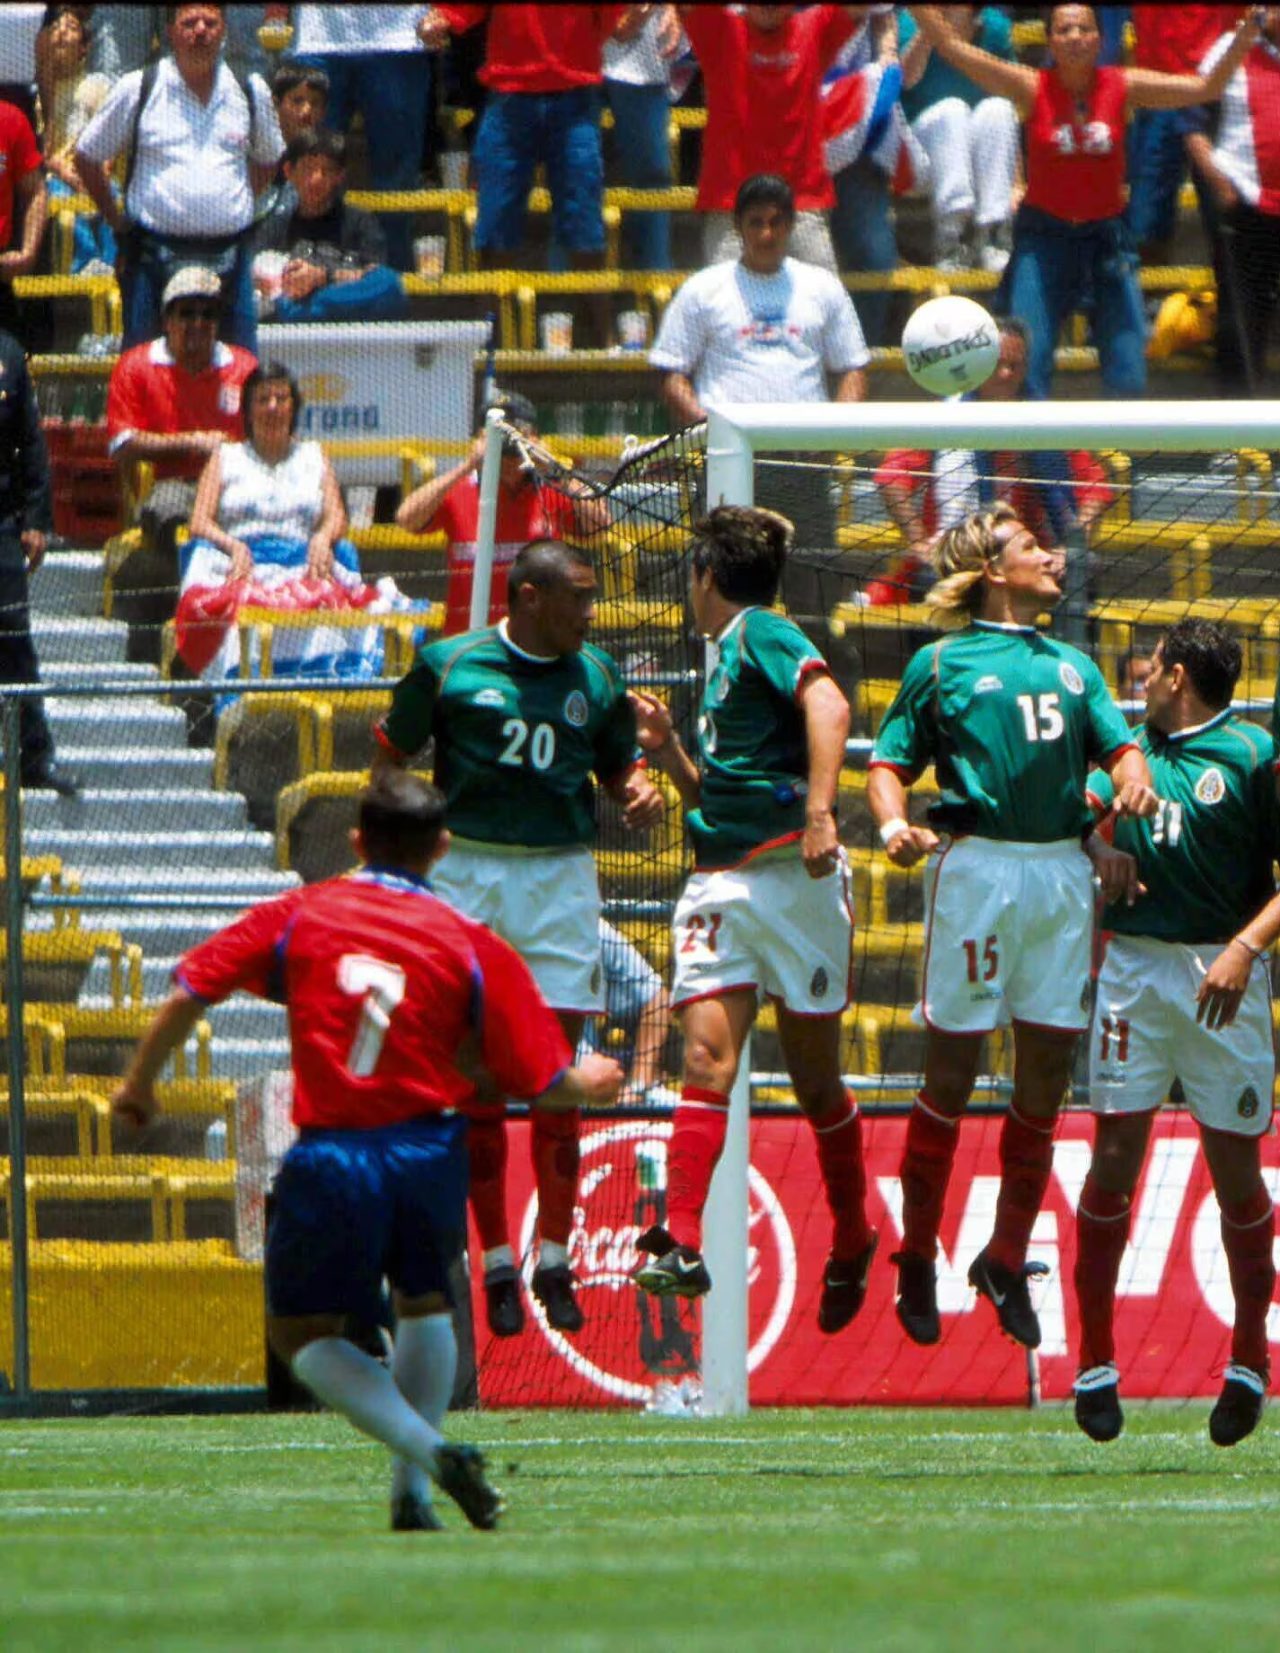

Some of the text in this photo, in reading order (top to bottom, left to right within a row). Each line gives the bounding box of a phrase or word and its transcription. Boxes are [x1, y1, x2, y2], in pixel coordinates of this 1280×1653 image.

[303, 403, 380, 432] rona
[1016, 692, 1064, 741] 15
[499, 718, 555, 769] 20
[962, 934, 999, 983] 15
[336, 953, 407, 1077] 7
